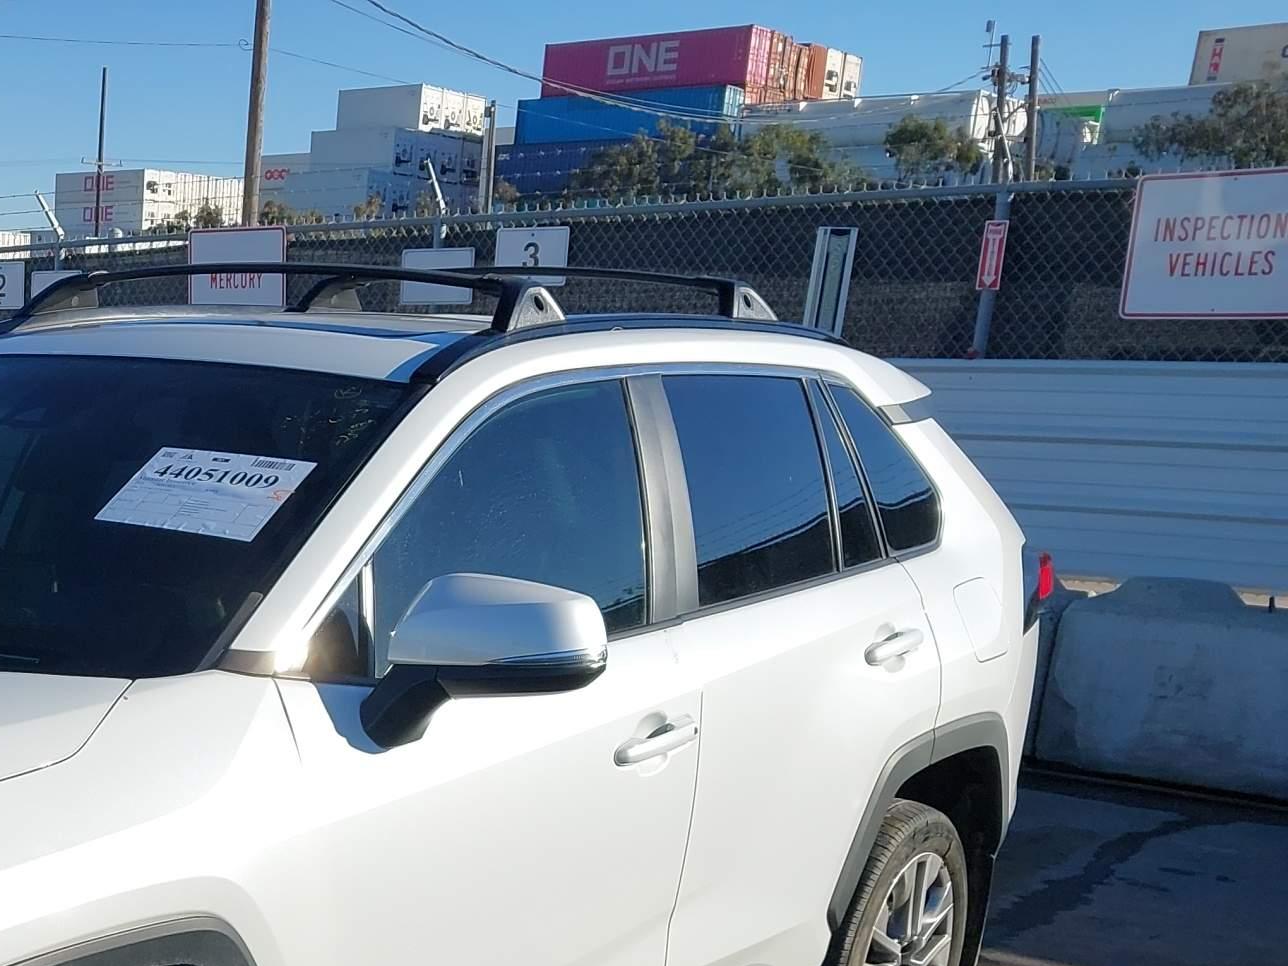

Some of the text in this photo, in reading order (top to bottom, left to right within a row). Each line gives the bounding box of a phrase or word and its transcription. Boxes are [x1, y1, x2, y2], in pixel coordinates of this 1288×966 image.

[607, 40, 680, 75] ONE
[1153, 213, 1288, 242] INSPECTION
[522, 242, 540, 267] 3
[1168, 250, 1276, 278] VEHICLES
[210, 272, 264, 289] MERCURY
[153, 463, 280, 489] 44051009
